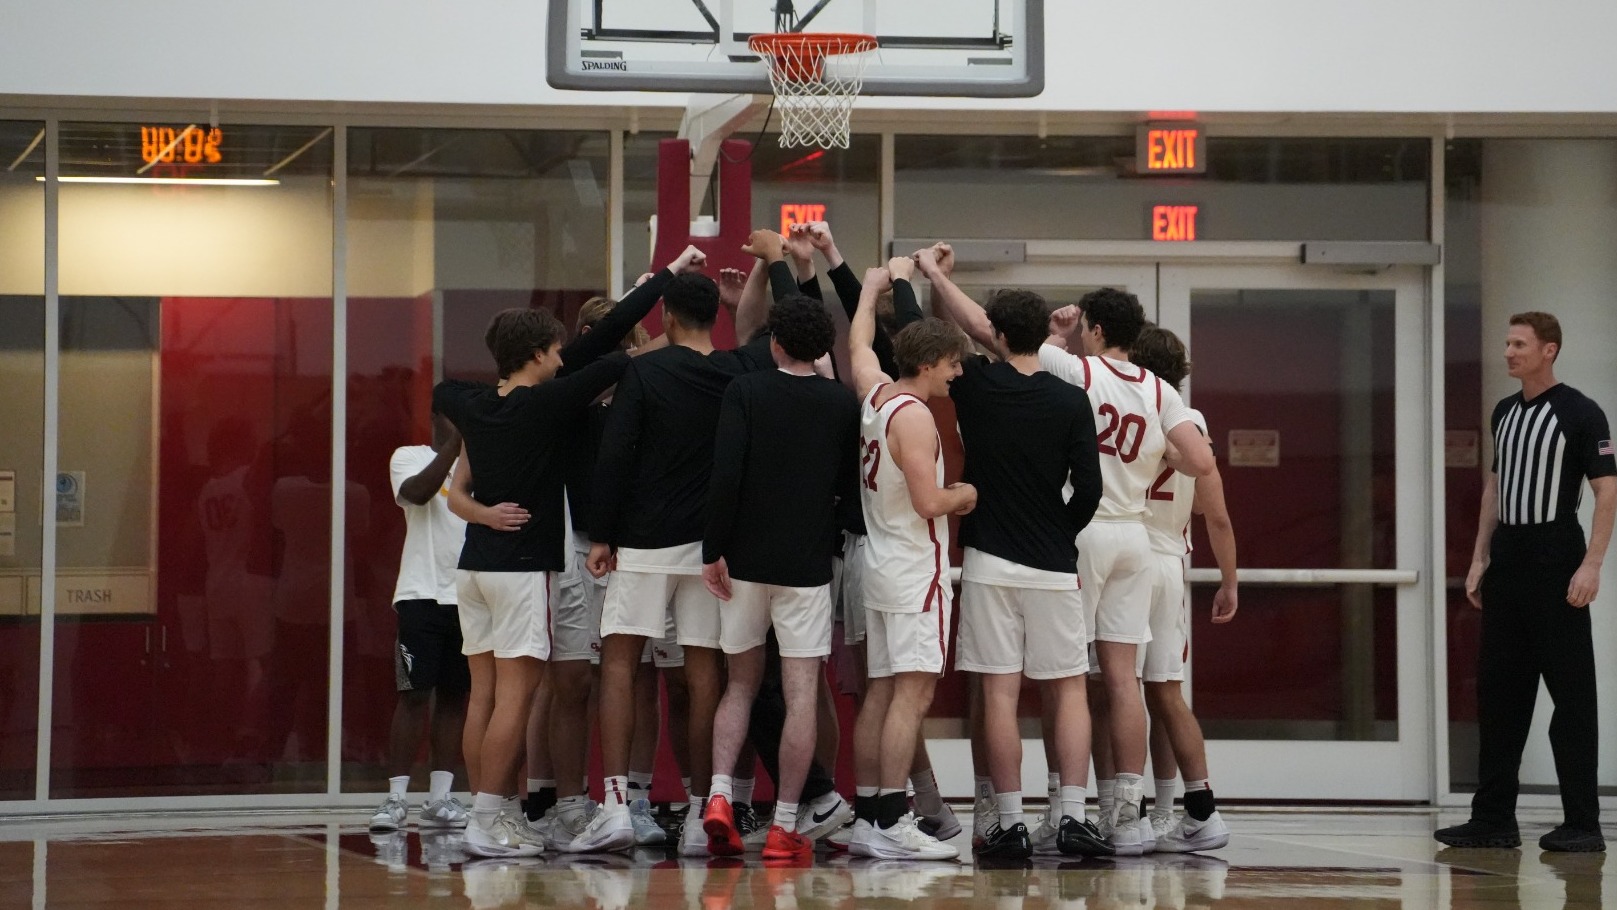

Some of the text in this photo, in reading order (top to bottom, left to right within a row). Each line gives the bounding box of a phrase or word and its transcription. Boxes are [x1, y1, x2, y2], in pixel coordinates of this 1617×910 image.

[581, 60, 627, 71] SPALDING
[1148, 129, 1198, 169] EXIT
[1152, 205, 1198, 241] EXIT
[1096, 402, 1147, 464] 20
[66, 589, 112, 603] TRASH
